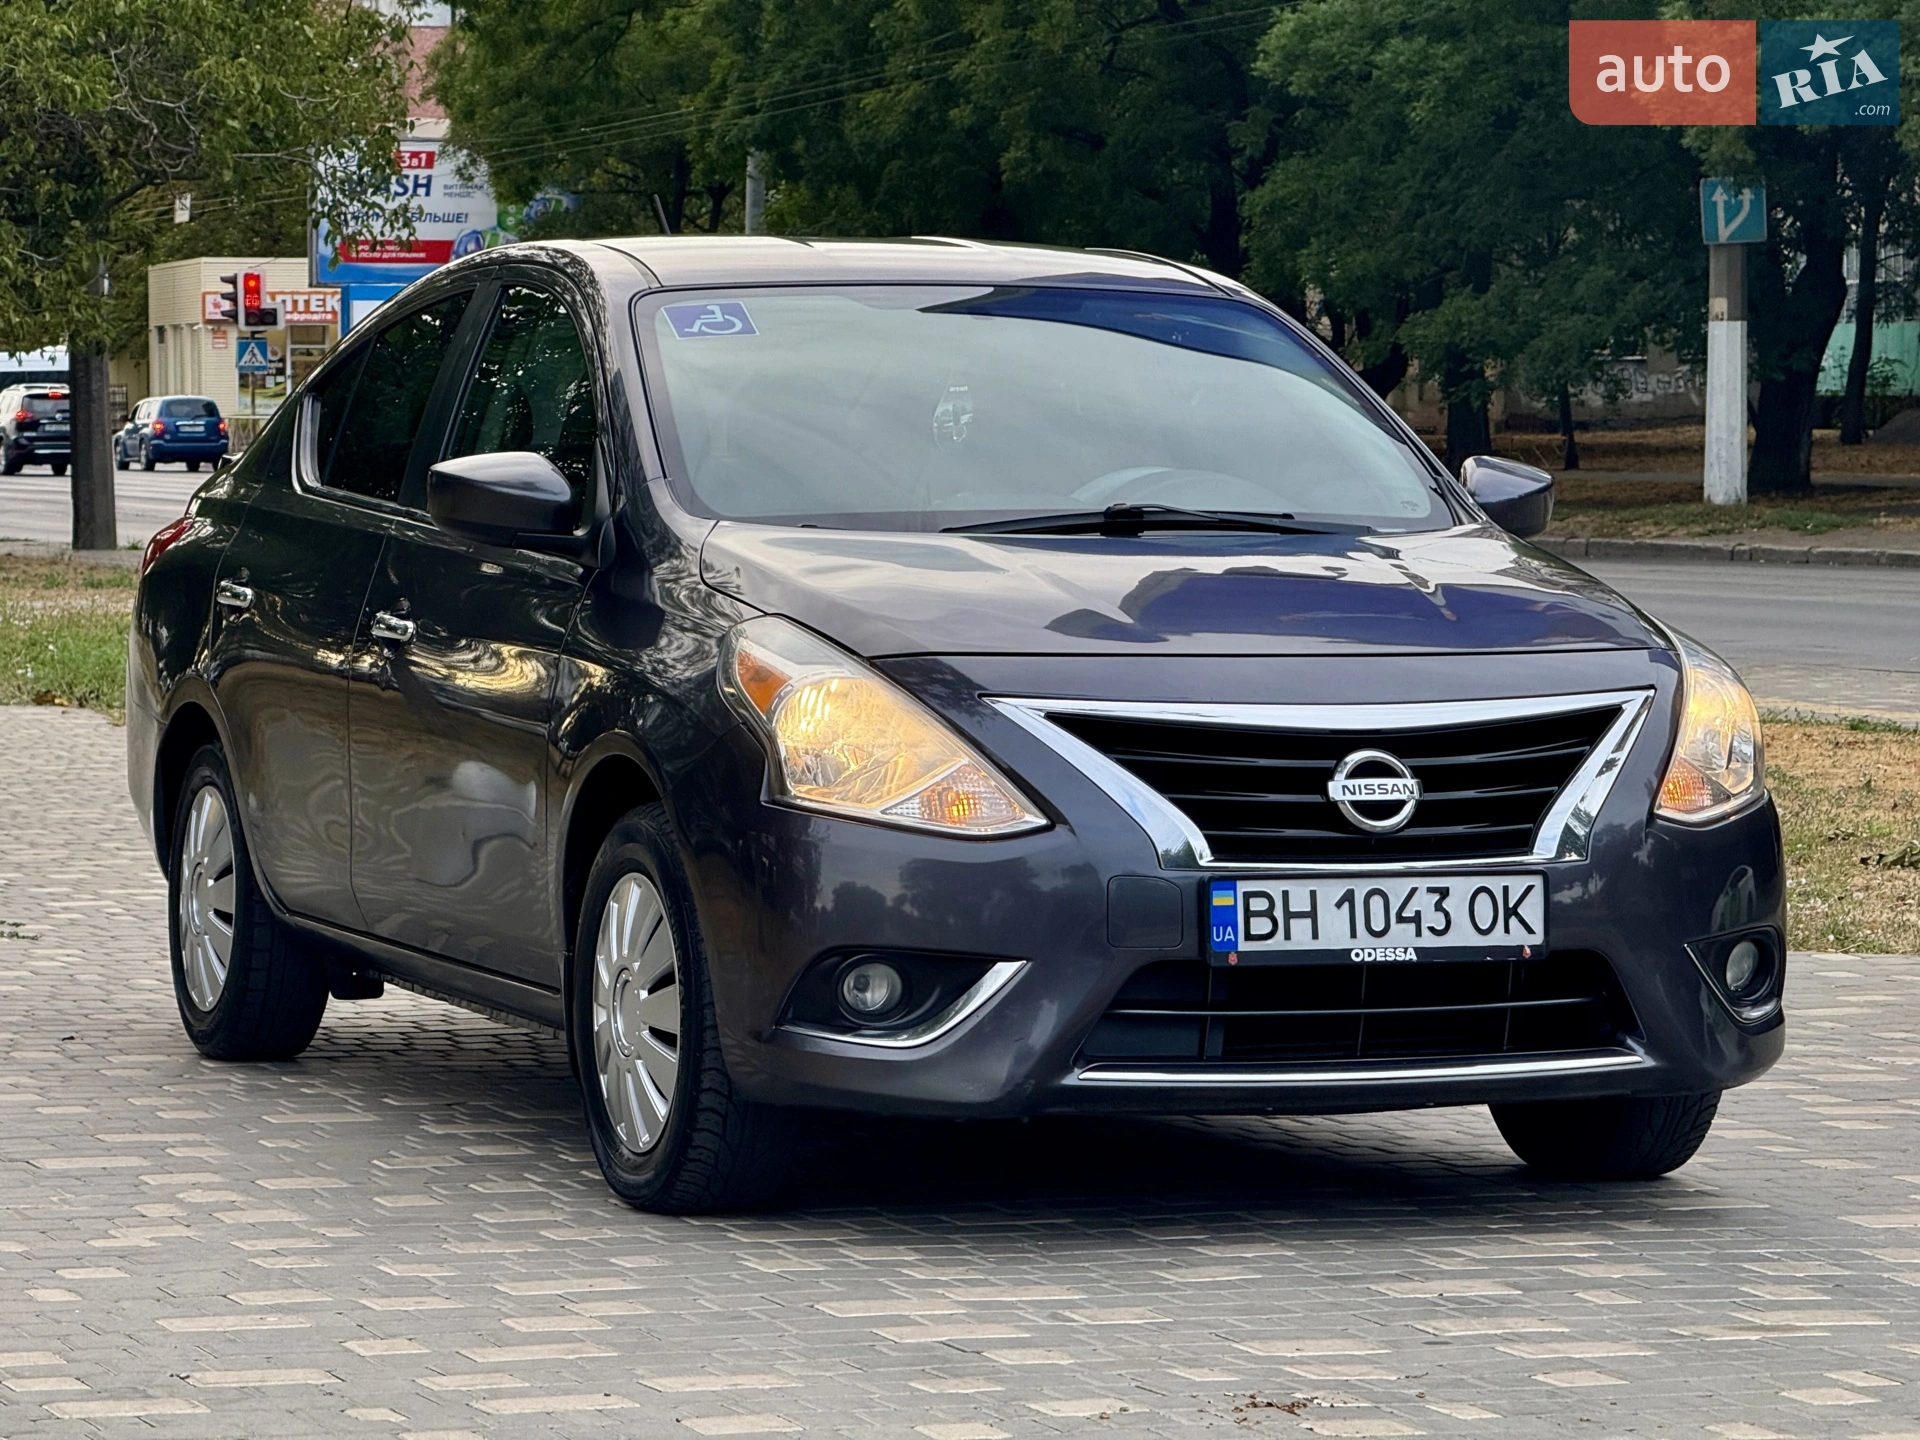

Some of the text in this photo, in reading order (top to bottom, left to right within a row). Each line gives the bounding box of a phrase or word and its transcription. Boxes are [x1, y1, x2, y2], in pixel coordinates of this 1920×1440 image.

[1341, 783, 1415, 796] NISSAN
[1242, 884, 1537, 941] BH 1043 OK
[1212, 925, 1235, 942] UA
[1350, 948, 1418, 962] ODESSA
